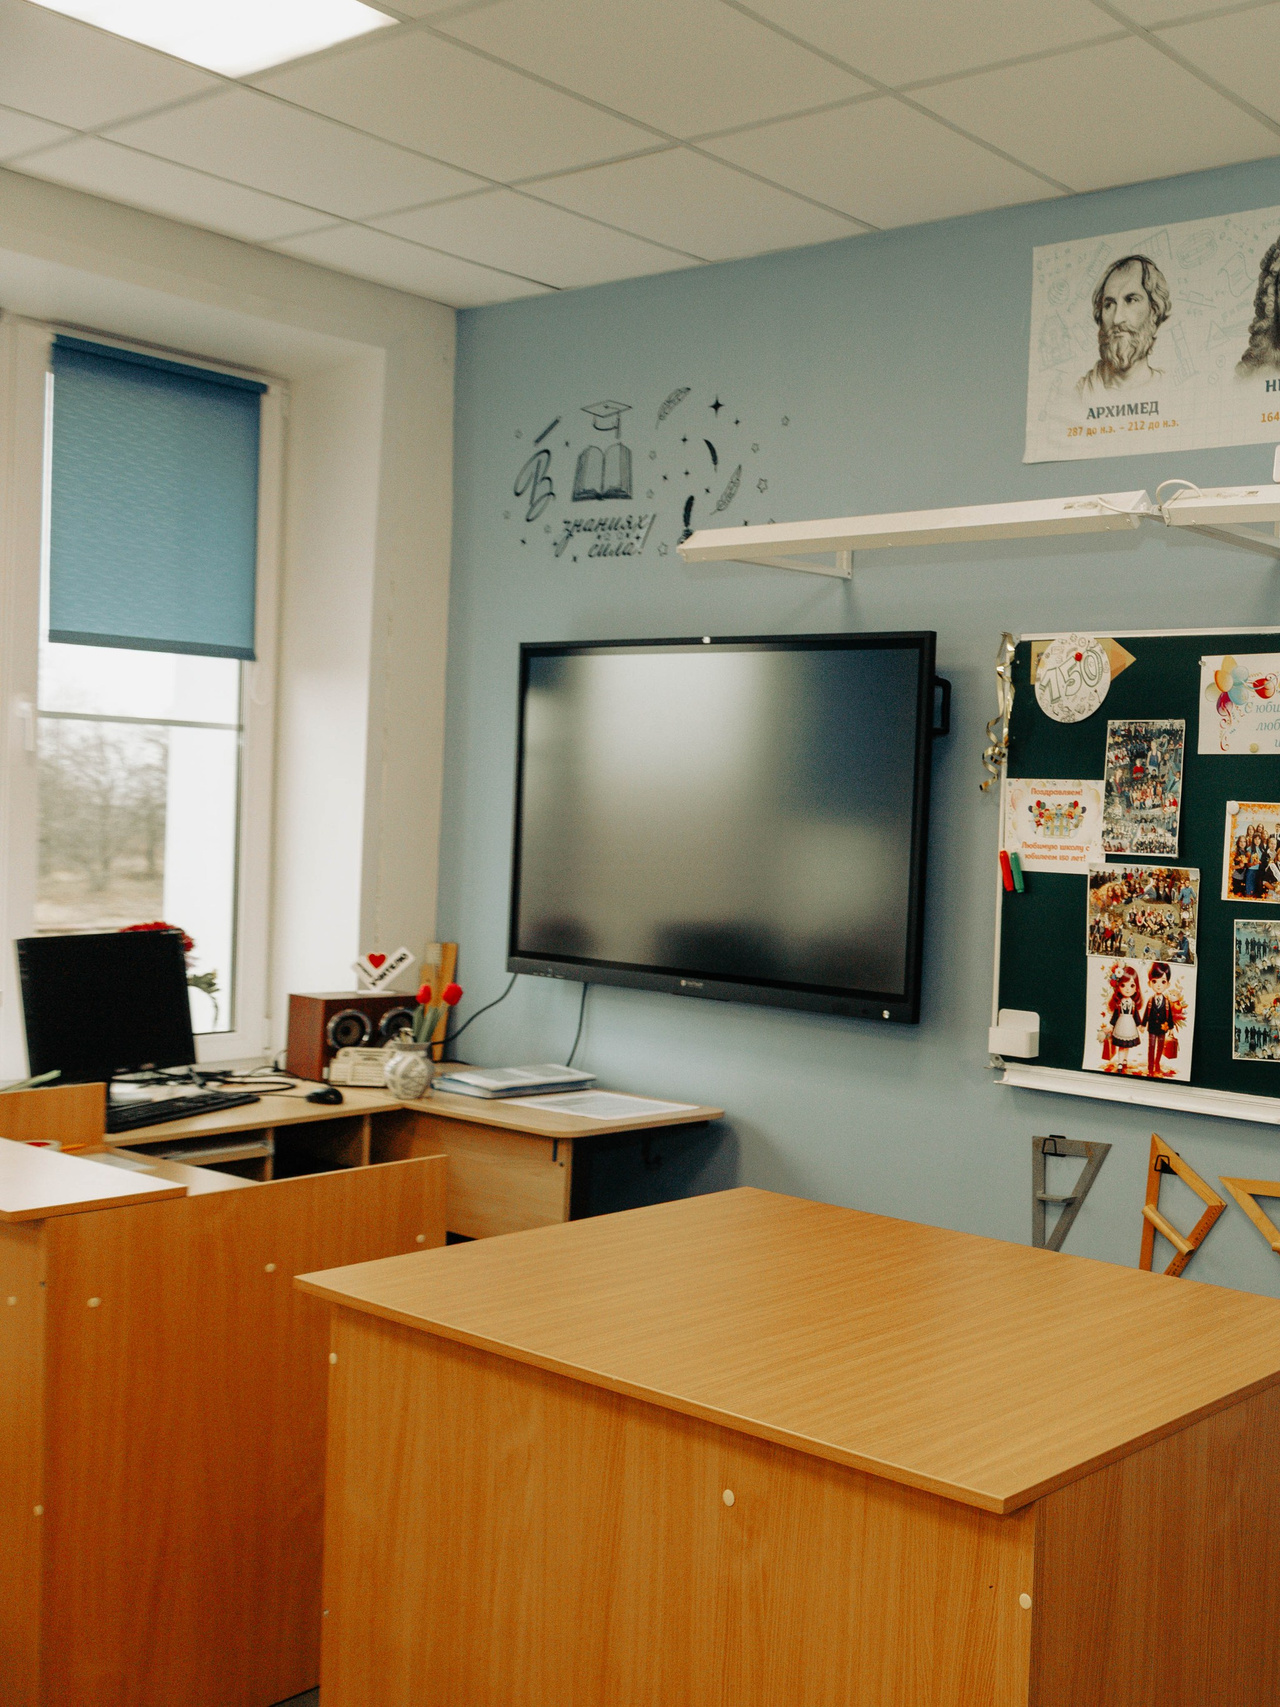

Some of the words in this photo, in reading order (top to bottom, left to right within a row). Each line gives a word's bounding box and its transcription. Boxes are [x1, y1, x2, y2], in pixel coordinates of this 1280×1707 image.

[1086, 401, 1159, 420] АРХИМЕД
[1066, 426, 1084, 438] 287
[1085, 426, 1098, 437] до
[1100, 426, 1116, 434] н.э.
[1127, 420, 1145, 432] 212
[1147, 420, 1160, 432] до
[1162, 419, 1180, 428] н.э.
[1038, 649, 1104, 705] 150
[1244, 702, 1254, 714] С
[1030, 787, 1083, 797] Поздравляем!
[1060, 842, 1084, 853] школу
